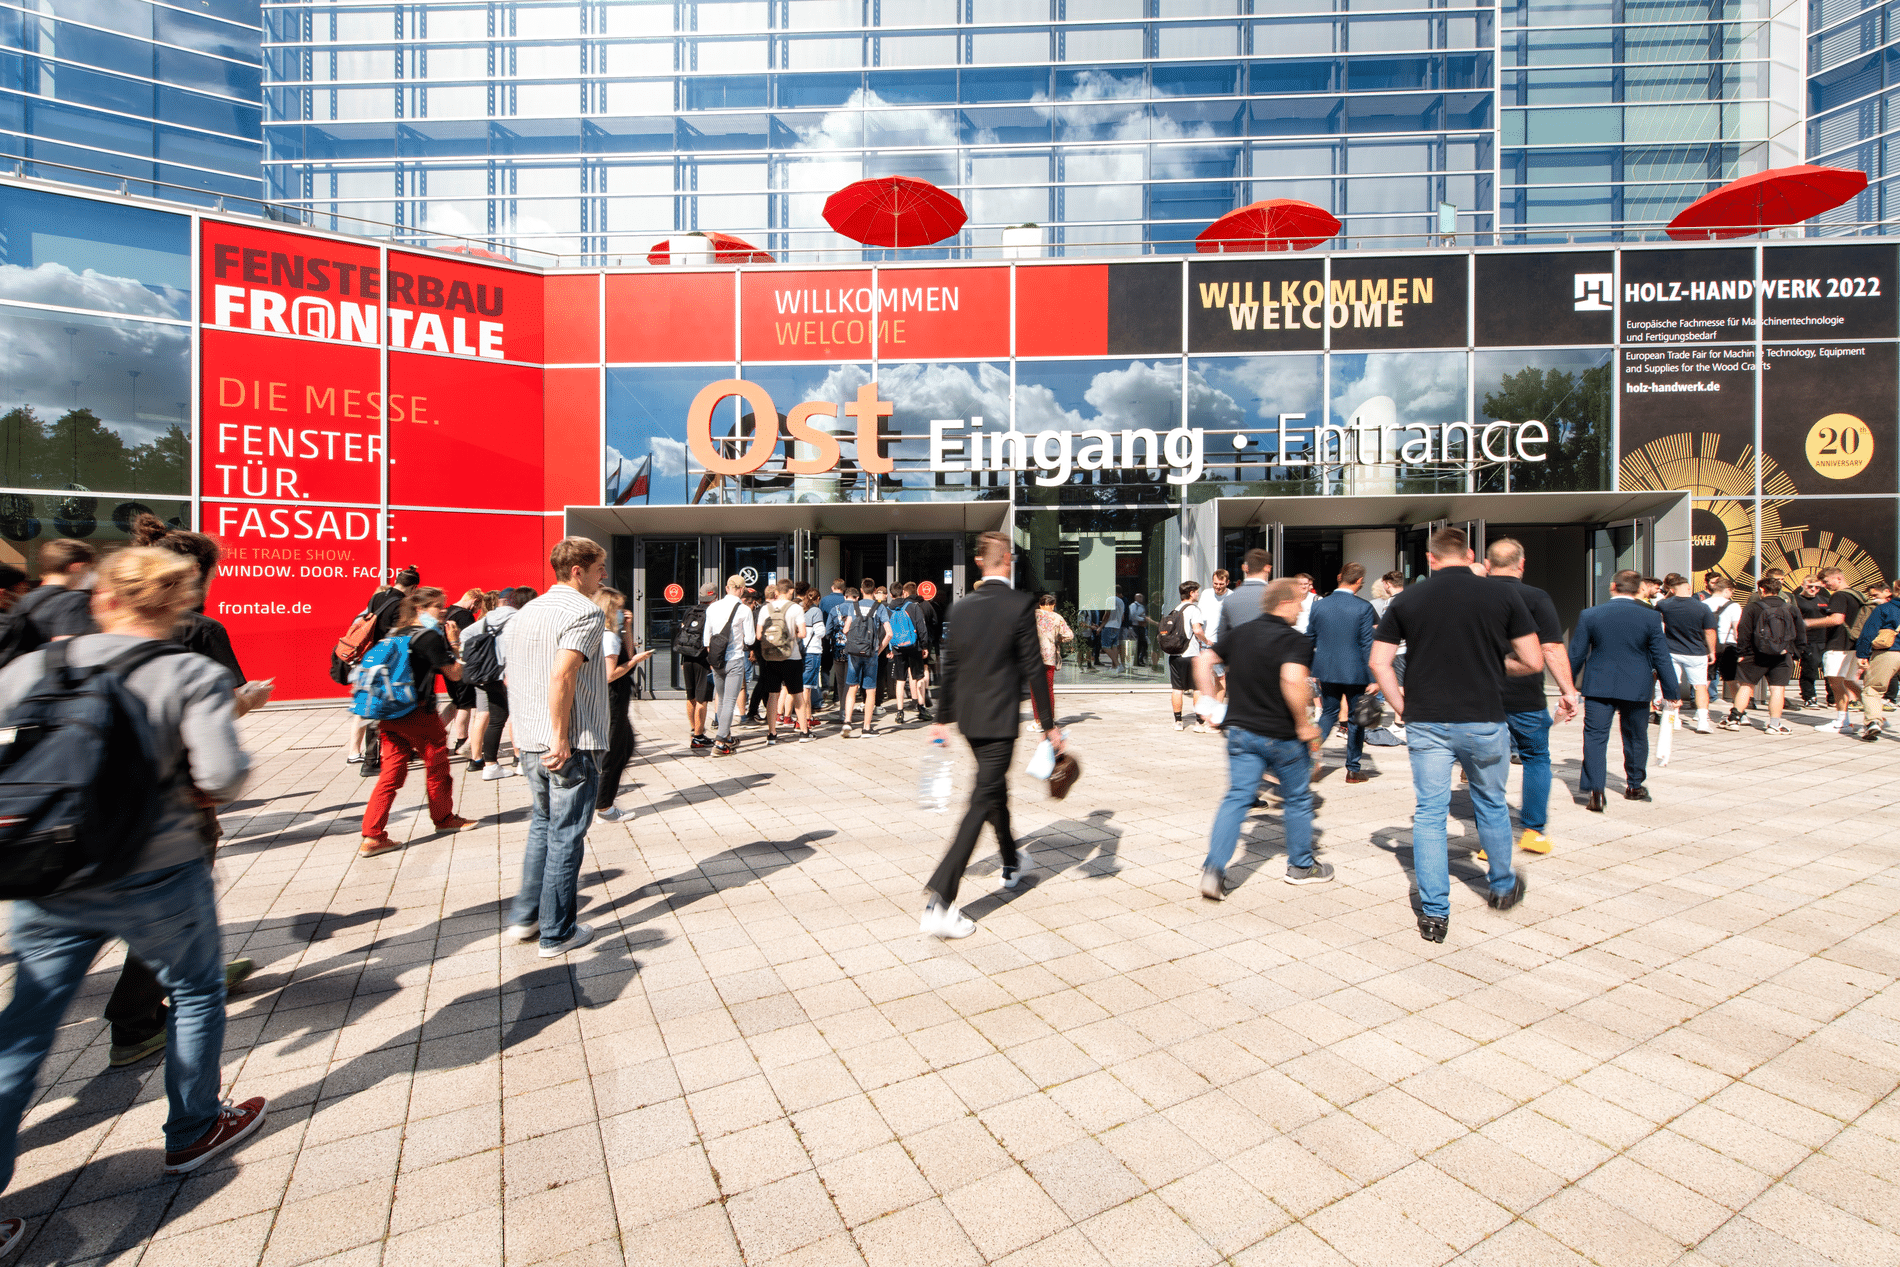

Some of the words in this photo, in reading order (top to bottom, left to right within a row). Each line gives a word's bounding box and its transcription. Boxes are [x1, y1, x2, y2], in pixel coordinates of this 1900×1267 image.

[215, 243, 503, 317] FENSTERBAU
[1199, 278, 1433, 308] WILLKOMMEN
[1625, 278, 1822, 302] HOLZ-HANDWERK
[1826, 276, 1881, 298] 2022
[775, 287, 959, 314] WILLKOMMEN
[215, 284, 504, 360] FRONTALE
[1228, 300, 1404, 330] WELCOME
[1626, 320, 1677, 331] Europäische
[1679, 318, 1725, 328] Fachmesse
[1727, 317, 1739, 327] für
[775, 320, 906, 345] WELCOME
[1626, 332, 1643, 342] und
[1645, 331, 1717, 343] Fertigungsbedarf
[1626, 351, 1665, 361] European
[1667, 350, 1690, 360] Trade
[1692, 350, 1707, 360] Fair
[1709, 350, 1721, 359] for
[1766, 347, 1817, 359] Technology,
[1819, 347, 1865, 357] Equipment
[1626, 364, 1642, 373] and
[1644, 363, 1679, 374] Supplies
[1681, 362, 1693, 372] for
[1696, 362, 1711, 371] the
[1712, 362, 1739, 371] Wood
[1626, 380, 1721, 393] holz-handwerk.de
[219, 377, 288, 412] DIE
[306, 385, 439, 425] MESSE.
[219, 423, 396, 464] FENSTER.
[687, 378, 894, 475] Ost
[929, 417, 1204, 486] Eingang
[1278, 413, 1549, 467] Entrance
[1815, 459, 1863, 467] ANNIVERSARY
[215, 460, 309, 498] TÜR.
[219, 507, 408, 542] FASSADE.
[252, 549, 301, 561] TRADE
[306, 550, 355, 561] SHOW.
[218, 565, 295, 577] WINDOW.
[300, 566, 348, 578] DOOR.
[218, 601, 312, 615] frontale.de
